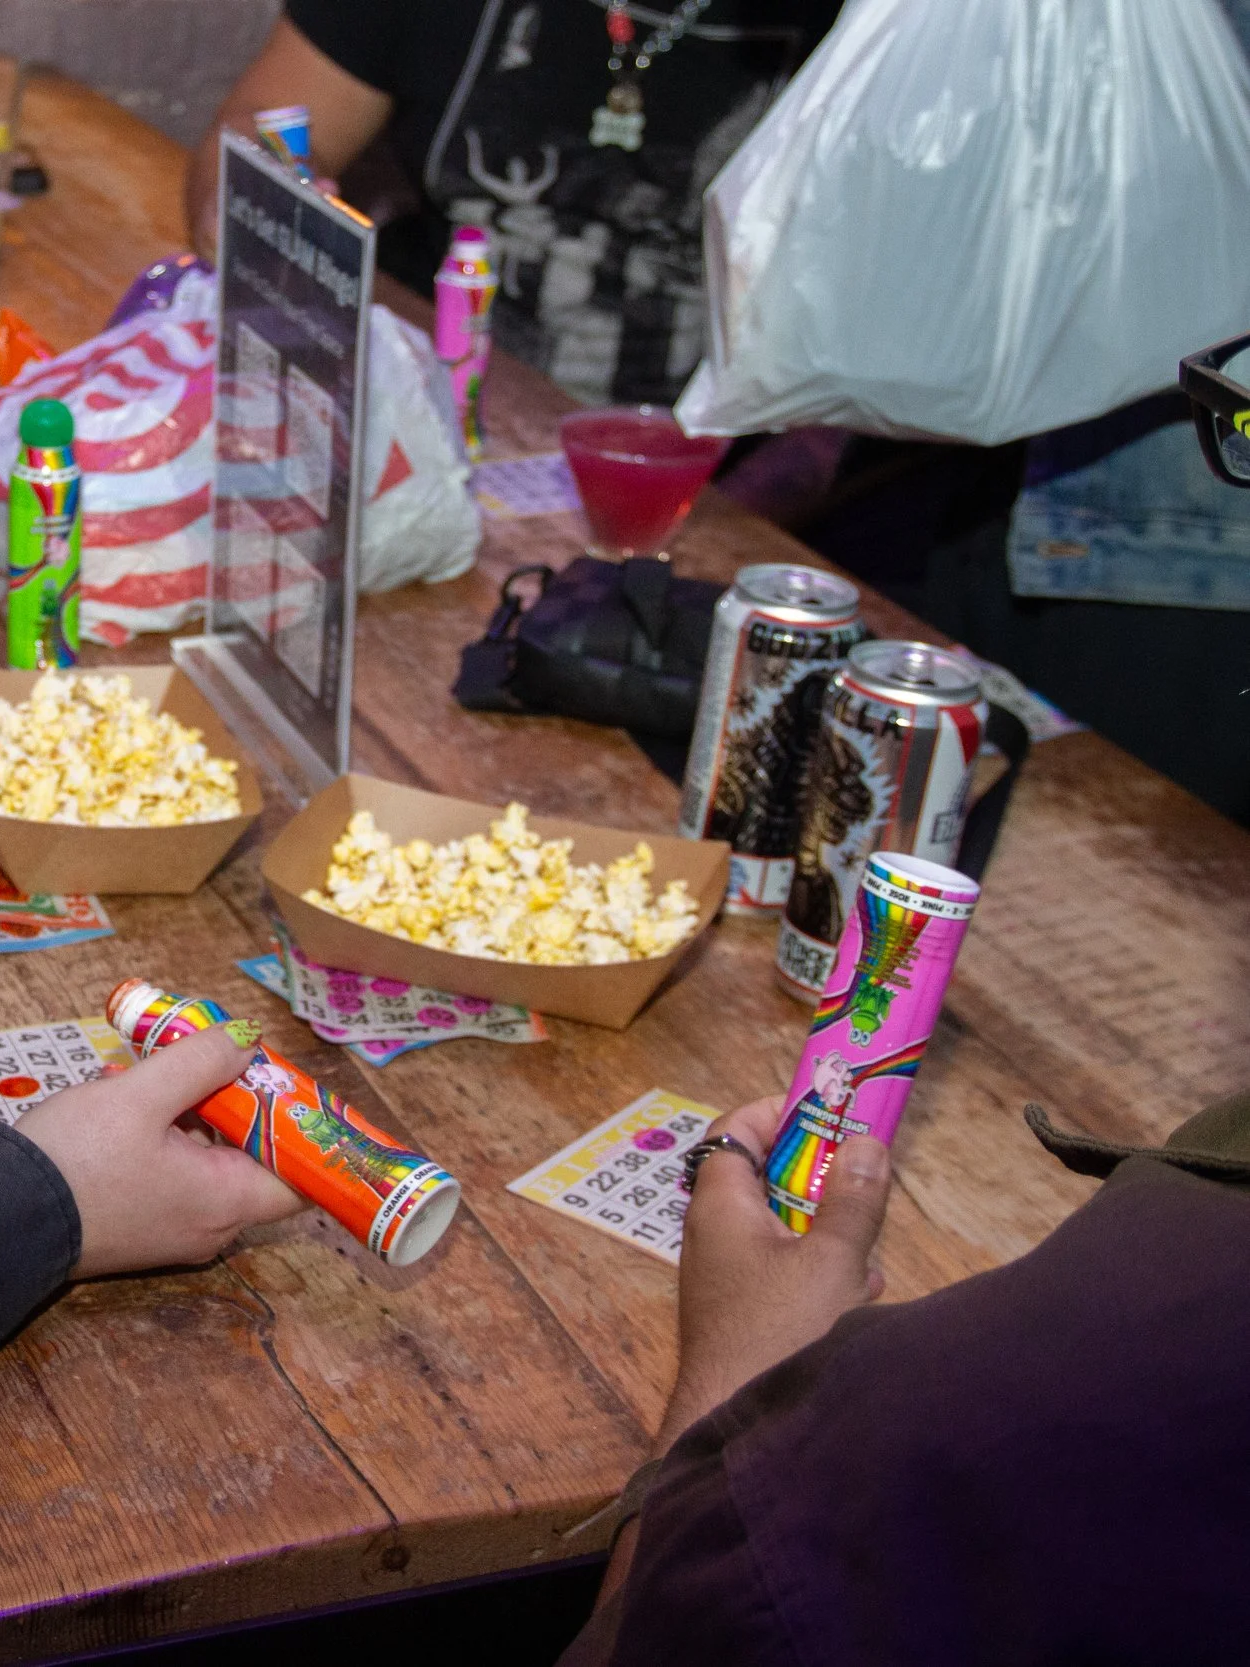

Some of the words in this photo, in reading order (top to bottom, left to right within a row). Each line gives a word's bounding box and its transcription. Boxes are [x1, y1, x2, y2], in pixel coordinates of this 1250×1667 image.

[888, 889, 911, 902] ROSE
[921, 900, 944, 912] PINK
[151, 1013, 172, 1039] ORANGE
[339, 1014, 369, 1025] 24
[19, 1032, 42, 1042] 4
[53, 1025, 81, 1041] 13
[67, 1046, 95, 1062] 16
[28, 1050, 59, 1067] 27
[44, 1072, 71, 1091] 42
[841, 1118, 870, 1134] SOYEZ
[563, 1195, 590, 1209] 9
[586, 1171, 624, 1193] 22
[614, 1152, 650, 1173] 38
[669, 1115, 704, 1134] 64
[383, 1186, 410, 1218] ORANGE
[598, 1209, 625, 1224] 5
[622, 1185, 658, 1207] 26
[651, 1165, 684, 1185] 40
[631, 1222, 666, 1242] 11
